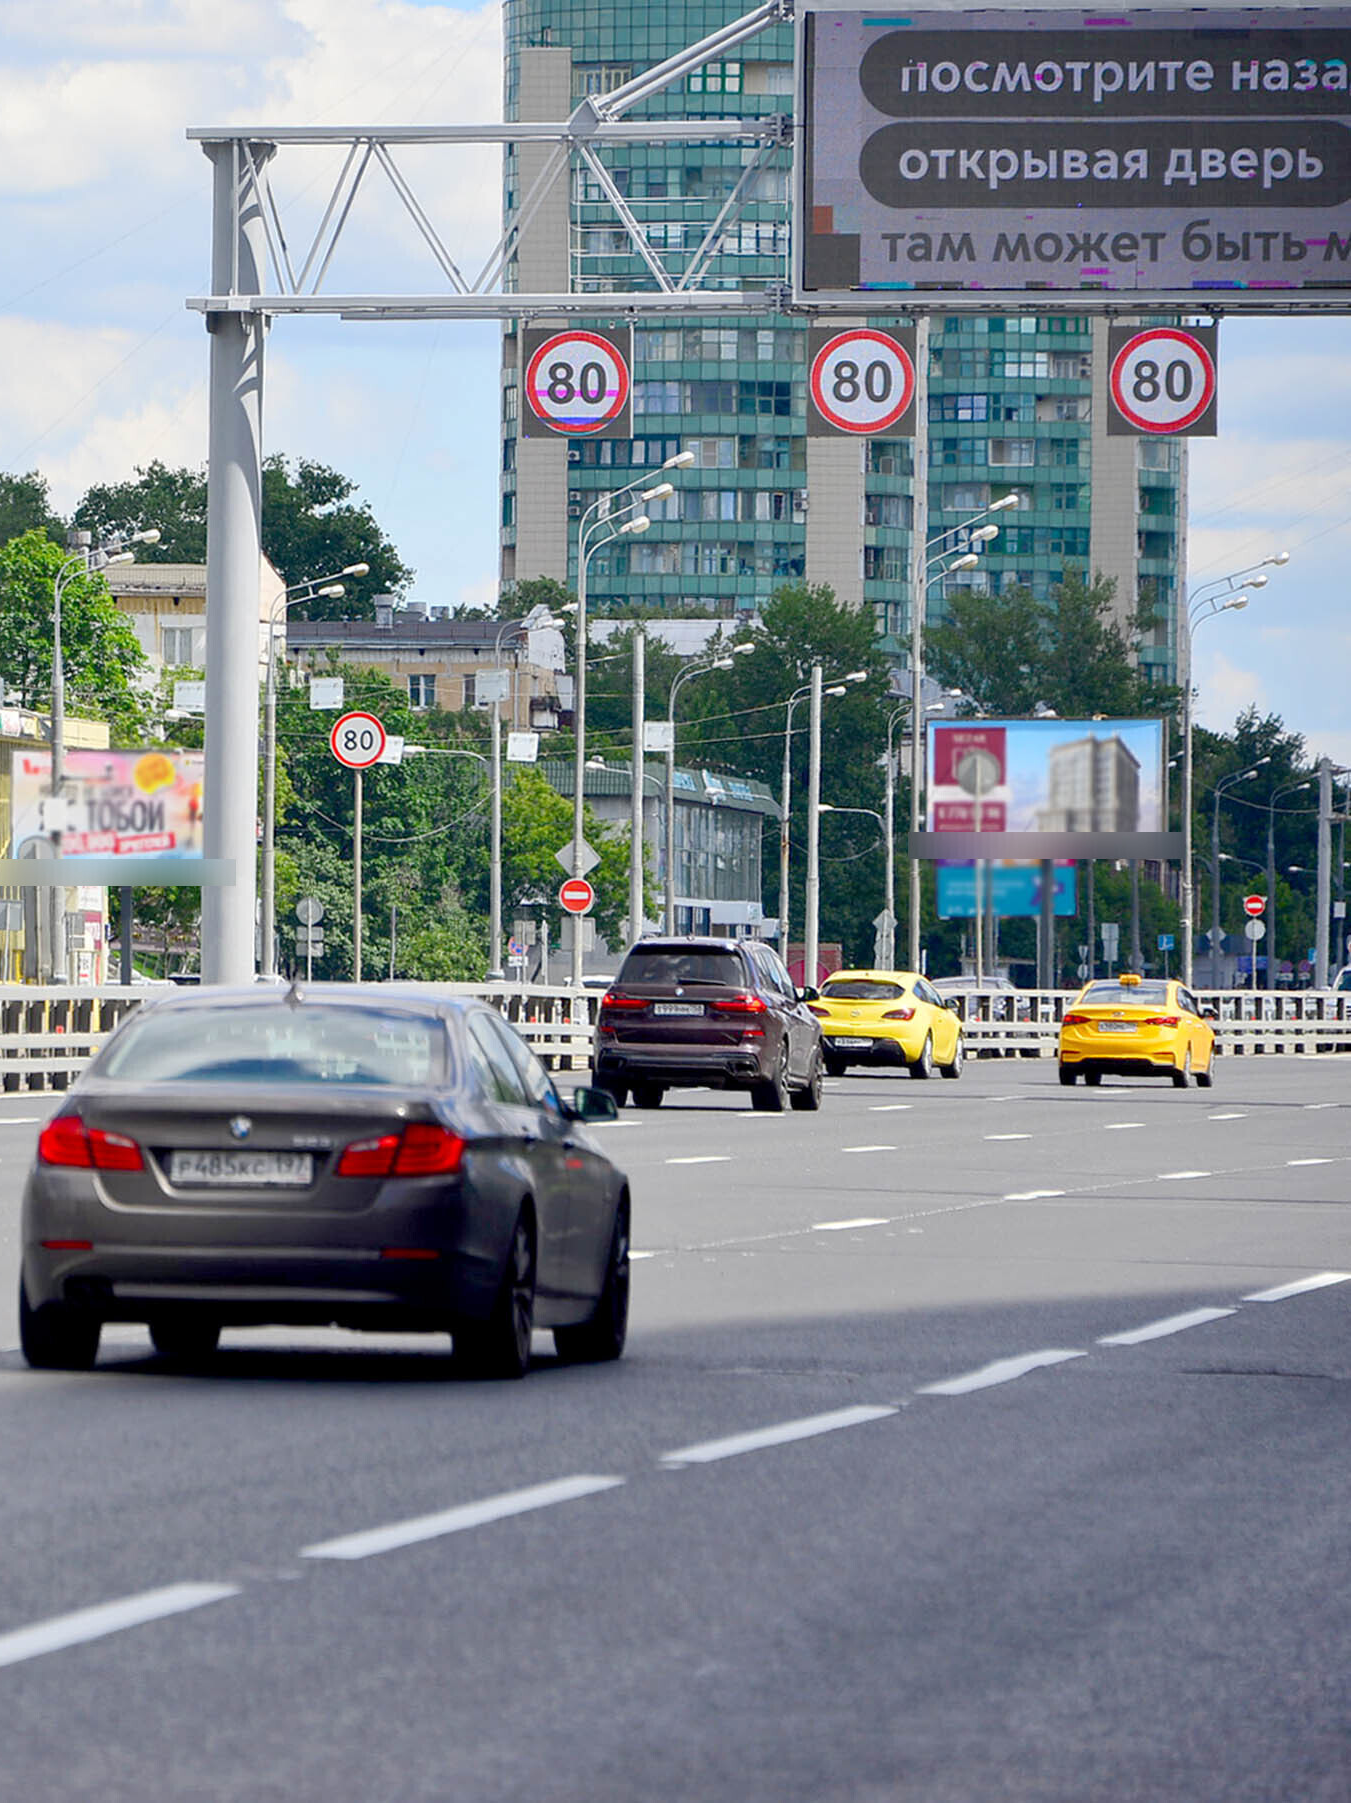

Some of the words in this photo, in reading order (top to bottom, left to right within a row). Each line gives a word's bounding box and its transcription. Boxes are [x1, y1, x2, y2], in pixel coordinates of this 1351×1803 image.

[900, 60, 1215, 103] посмотрите
[1232, 60, 1351, 92] наза
[899, 148, 1149, 190] открывая
[1163, 147, 1324, 189] дверь
[880, 231, 977, 263] там
[991, 231, 1167, 263] может
[1181, 218, 1308, 263] быть
[547, 359, 608, 405] 80
[832, 359, 893, 404] 80
[1132, 358, 1193, 403] 80
[343, 729, 374, 752] 80
